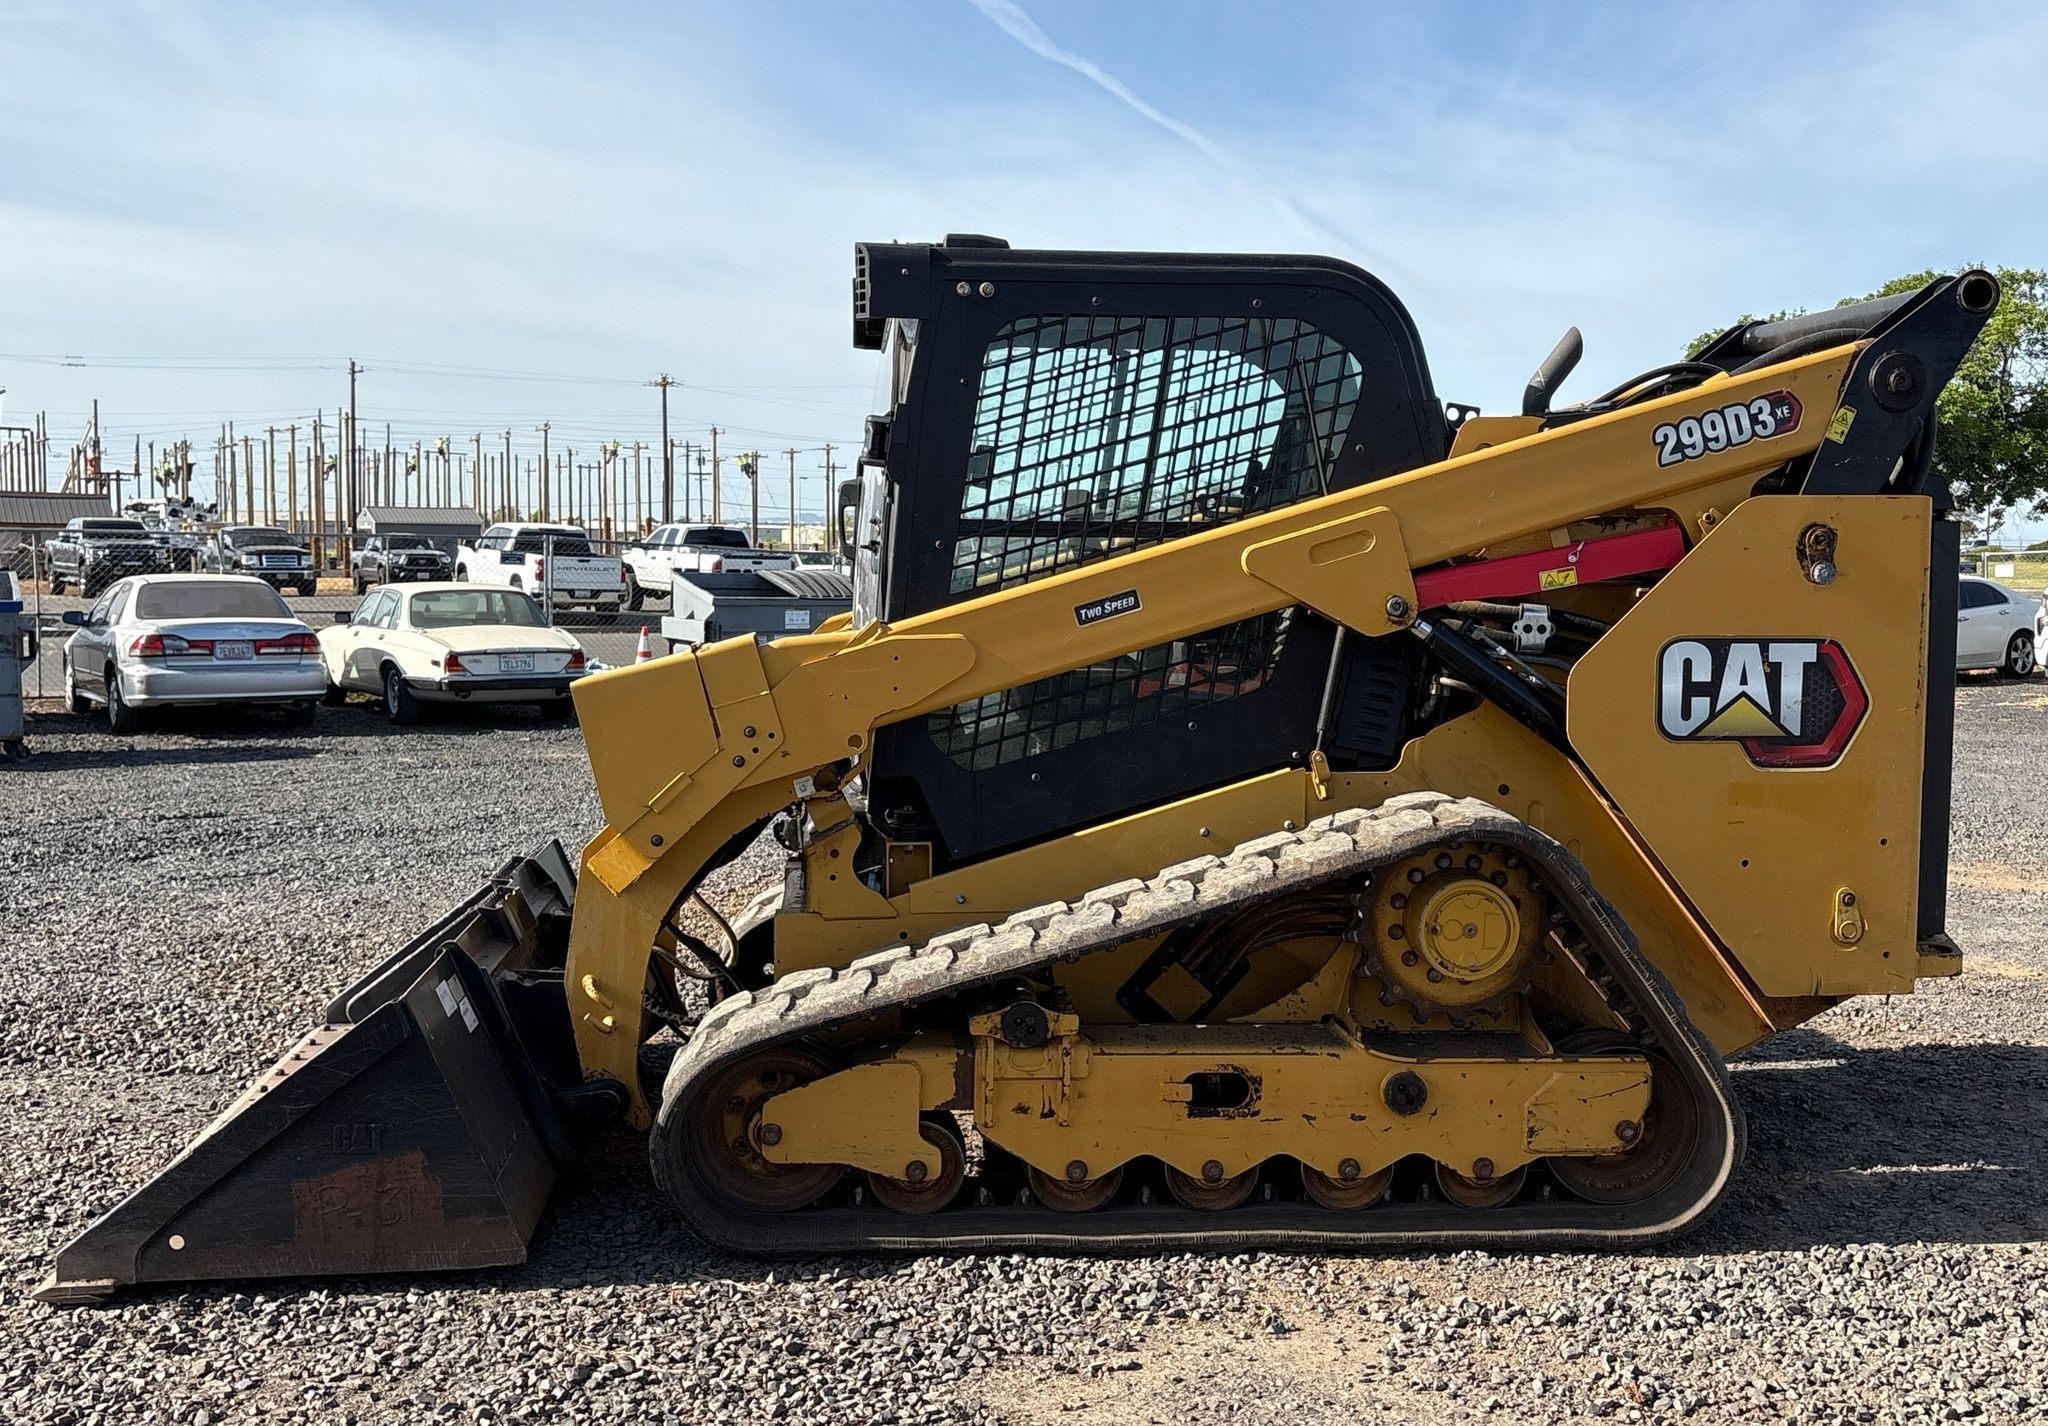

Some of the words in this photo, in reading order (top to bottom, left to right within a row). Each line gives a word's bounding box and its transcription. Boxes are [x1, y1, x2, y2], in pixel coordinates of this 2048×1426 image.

[1654, 399, 1777, 465] 299D3
[1775, 405, 1792, 421] XE
[1662, 641, 1817, 737] CAT
